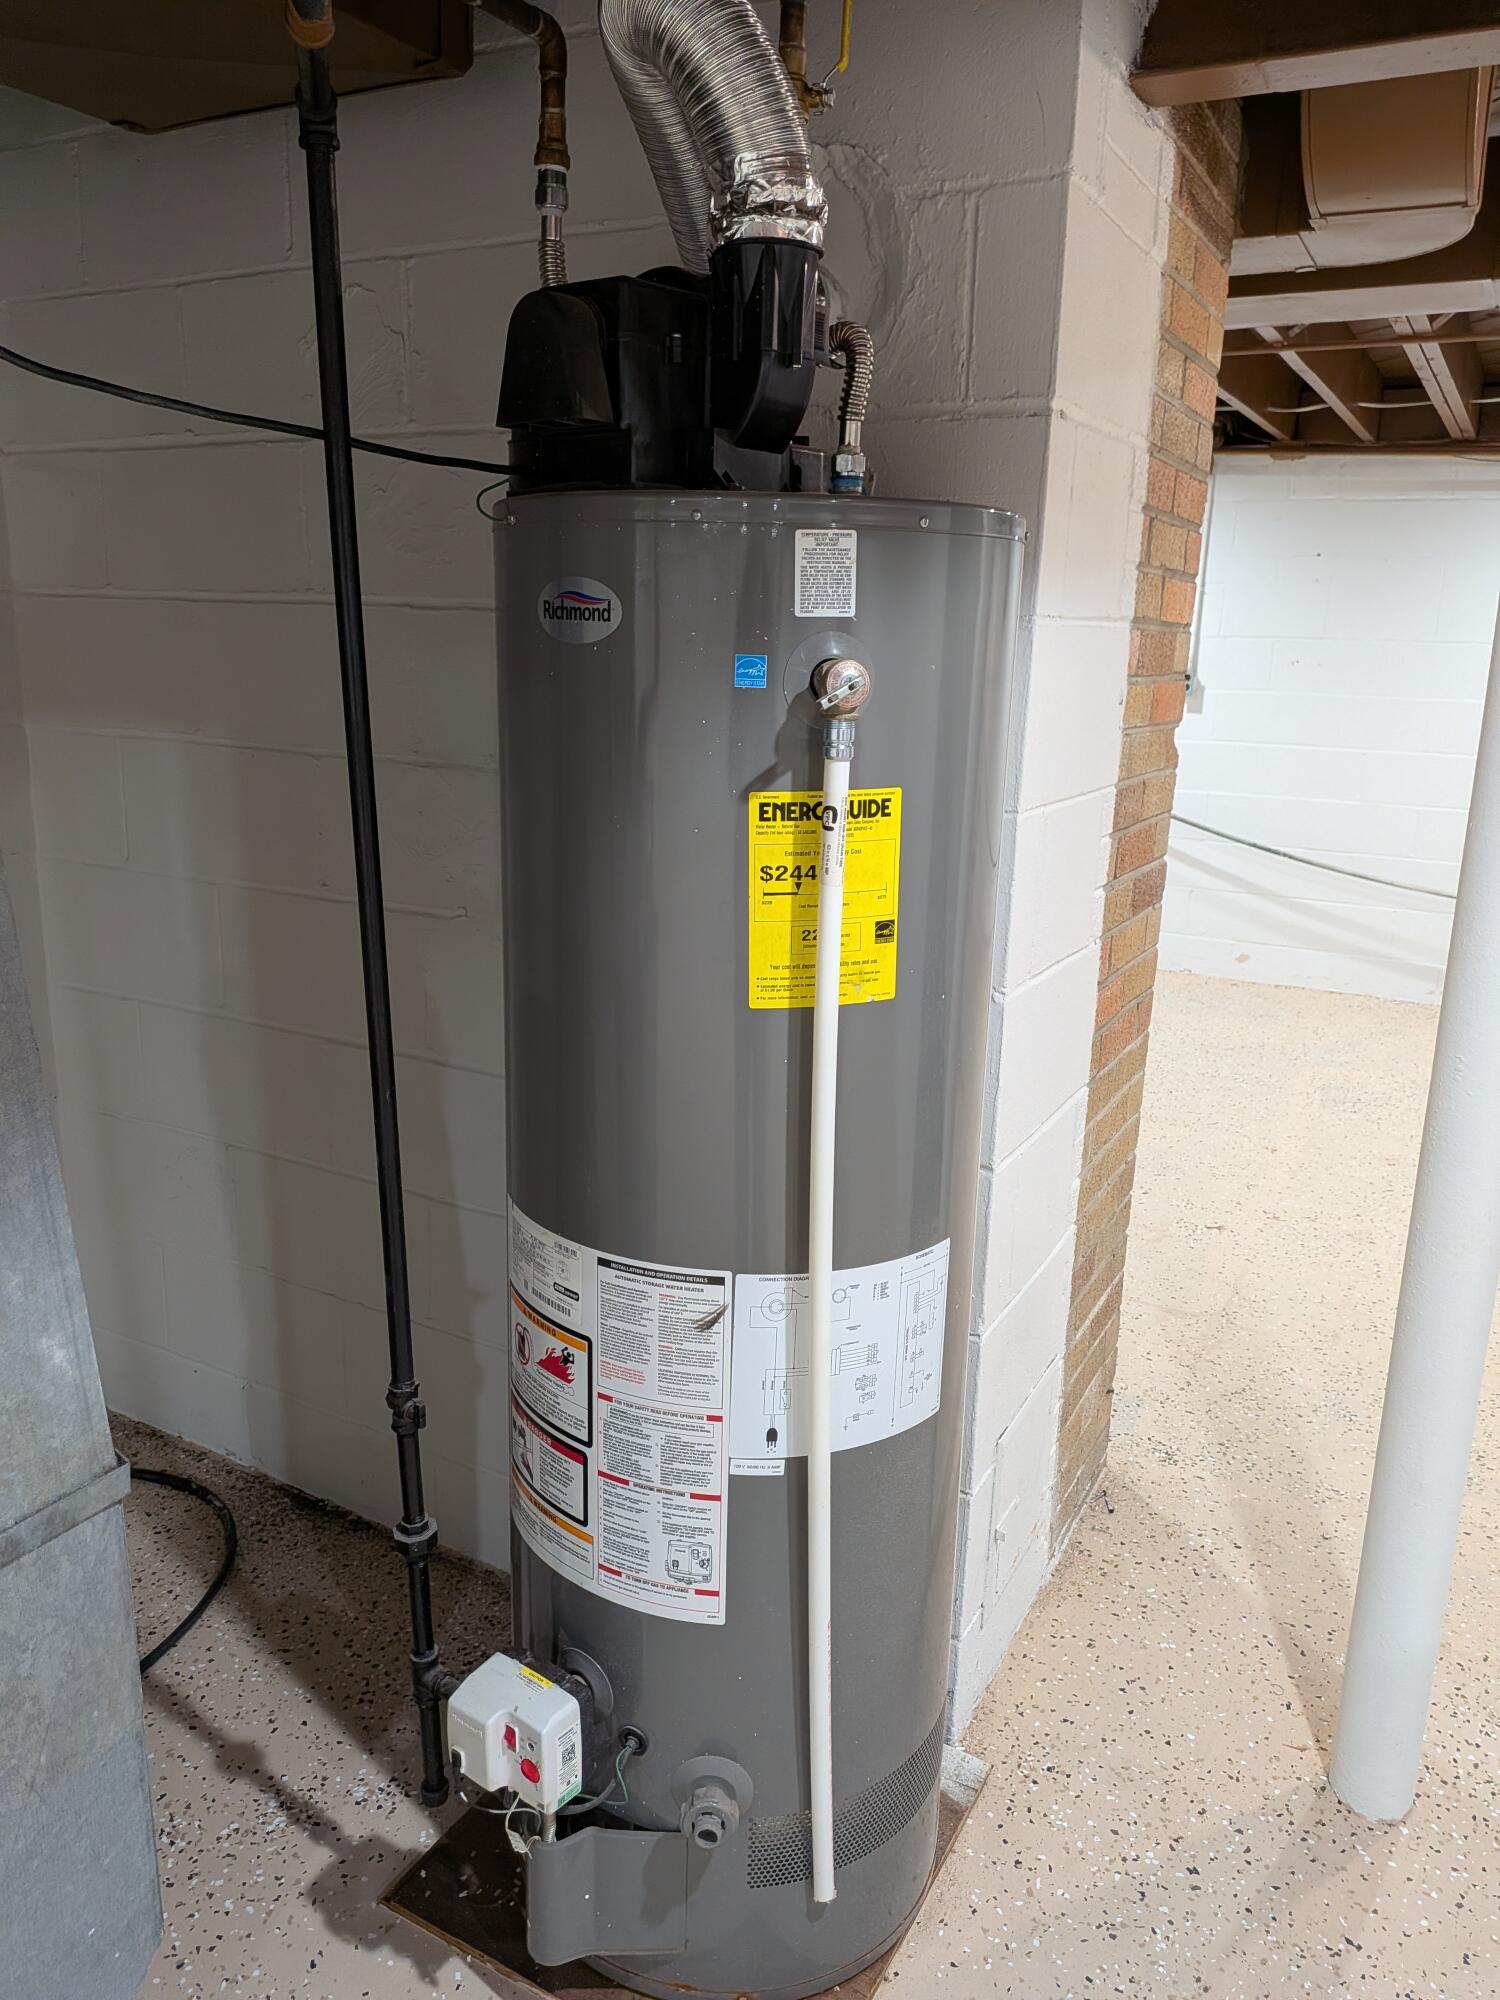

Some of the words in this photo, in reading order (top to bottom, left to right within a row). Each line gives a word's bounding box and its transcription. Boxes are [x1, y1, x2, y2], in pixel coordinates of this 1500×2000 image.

[543, 599, 611, 622] Richmond
[760, 864, 818, 883] $244
[611, 1263, 644, 1274] INSTALLATION
[656, 1272, 685, 1280] OPERATION
[615, 1274, 641, 1284] AUTOMATIC
[642, 1280, 664, 1288] STORAGE
[528, 1312, 556, 1337] WARNING
[527, 1422, 552, 1446] DANGER
[633, 1482, 655, 1492] OPERATING
[656, 1488, 685, 1497] INSTRUCTIONS
[532, 1498, 557, 1524] WARNING
[666, 1585, 689, 1593] APPLIANCE
